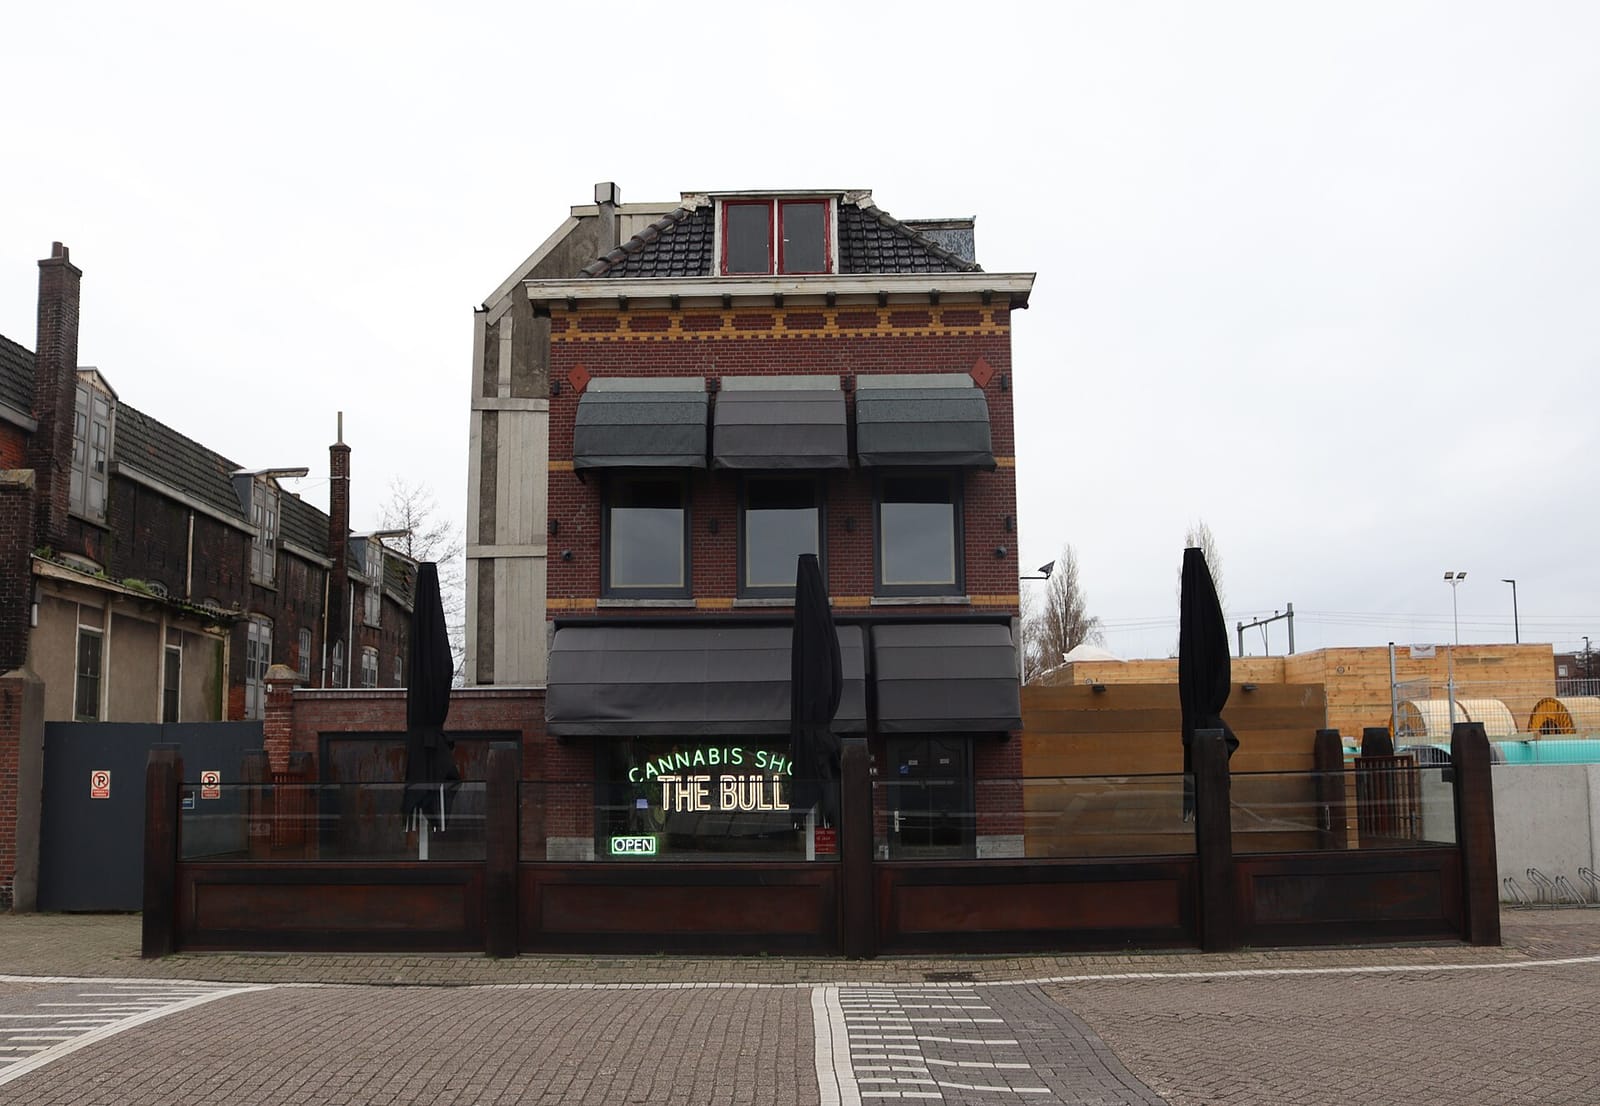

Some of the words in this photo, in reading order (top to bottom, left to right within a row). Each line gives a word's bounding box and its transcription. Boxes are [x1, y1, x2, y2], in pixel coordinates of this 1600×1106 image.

[628, 747, 743, 783] CANNABIS
[657, 775, 711, 812] THE
[719, 774, 790, 812] BULL
[614, 838, 653, 852] OPEN
